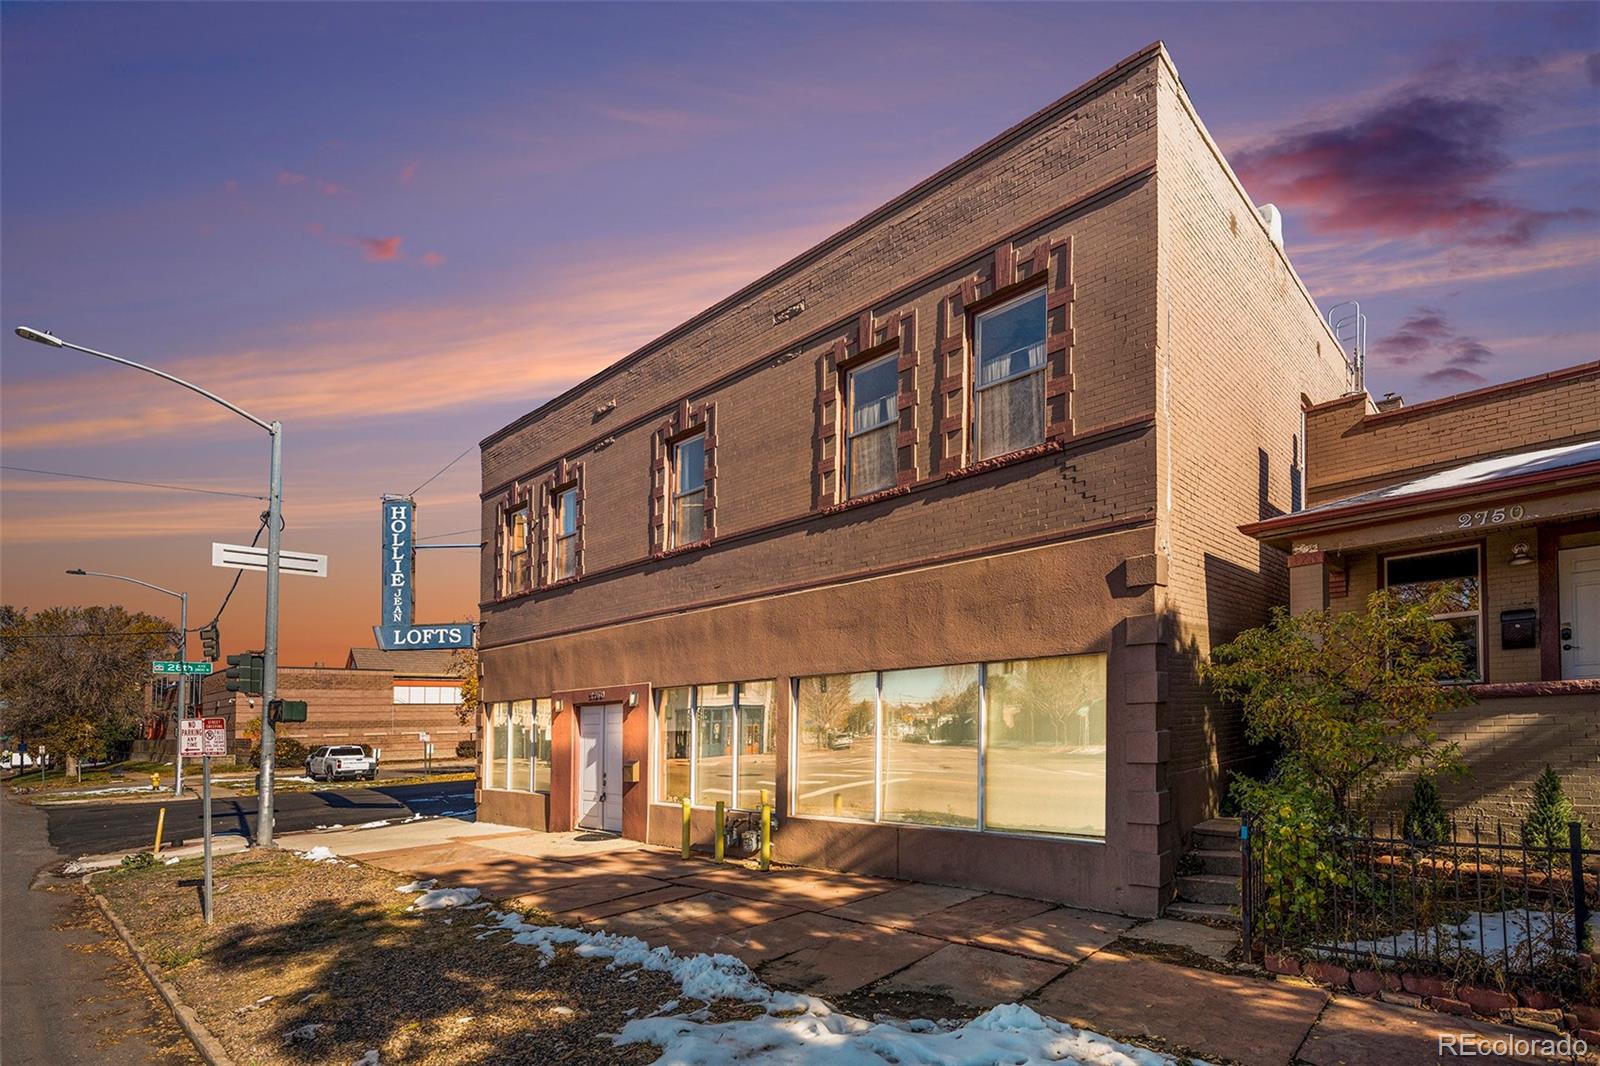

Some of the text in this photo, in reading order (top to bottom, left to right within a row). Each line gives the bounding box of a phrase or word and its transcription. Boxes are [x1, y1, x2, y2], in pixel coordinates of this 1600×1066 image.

[1458, 505, 1525, 529] 2750
[391, 506, 407, 622] HOLLIE JEAN
[394, 628, 462, 645] LOFTS
